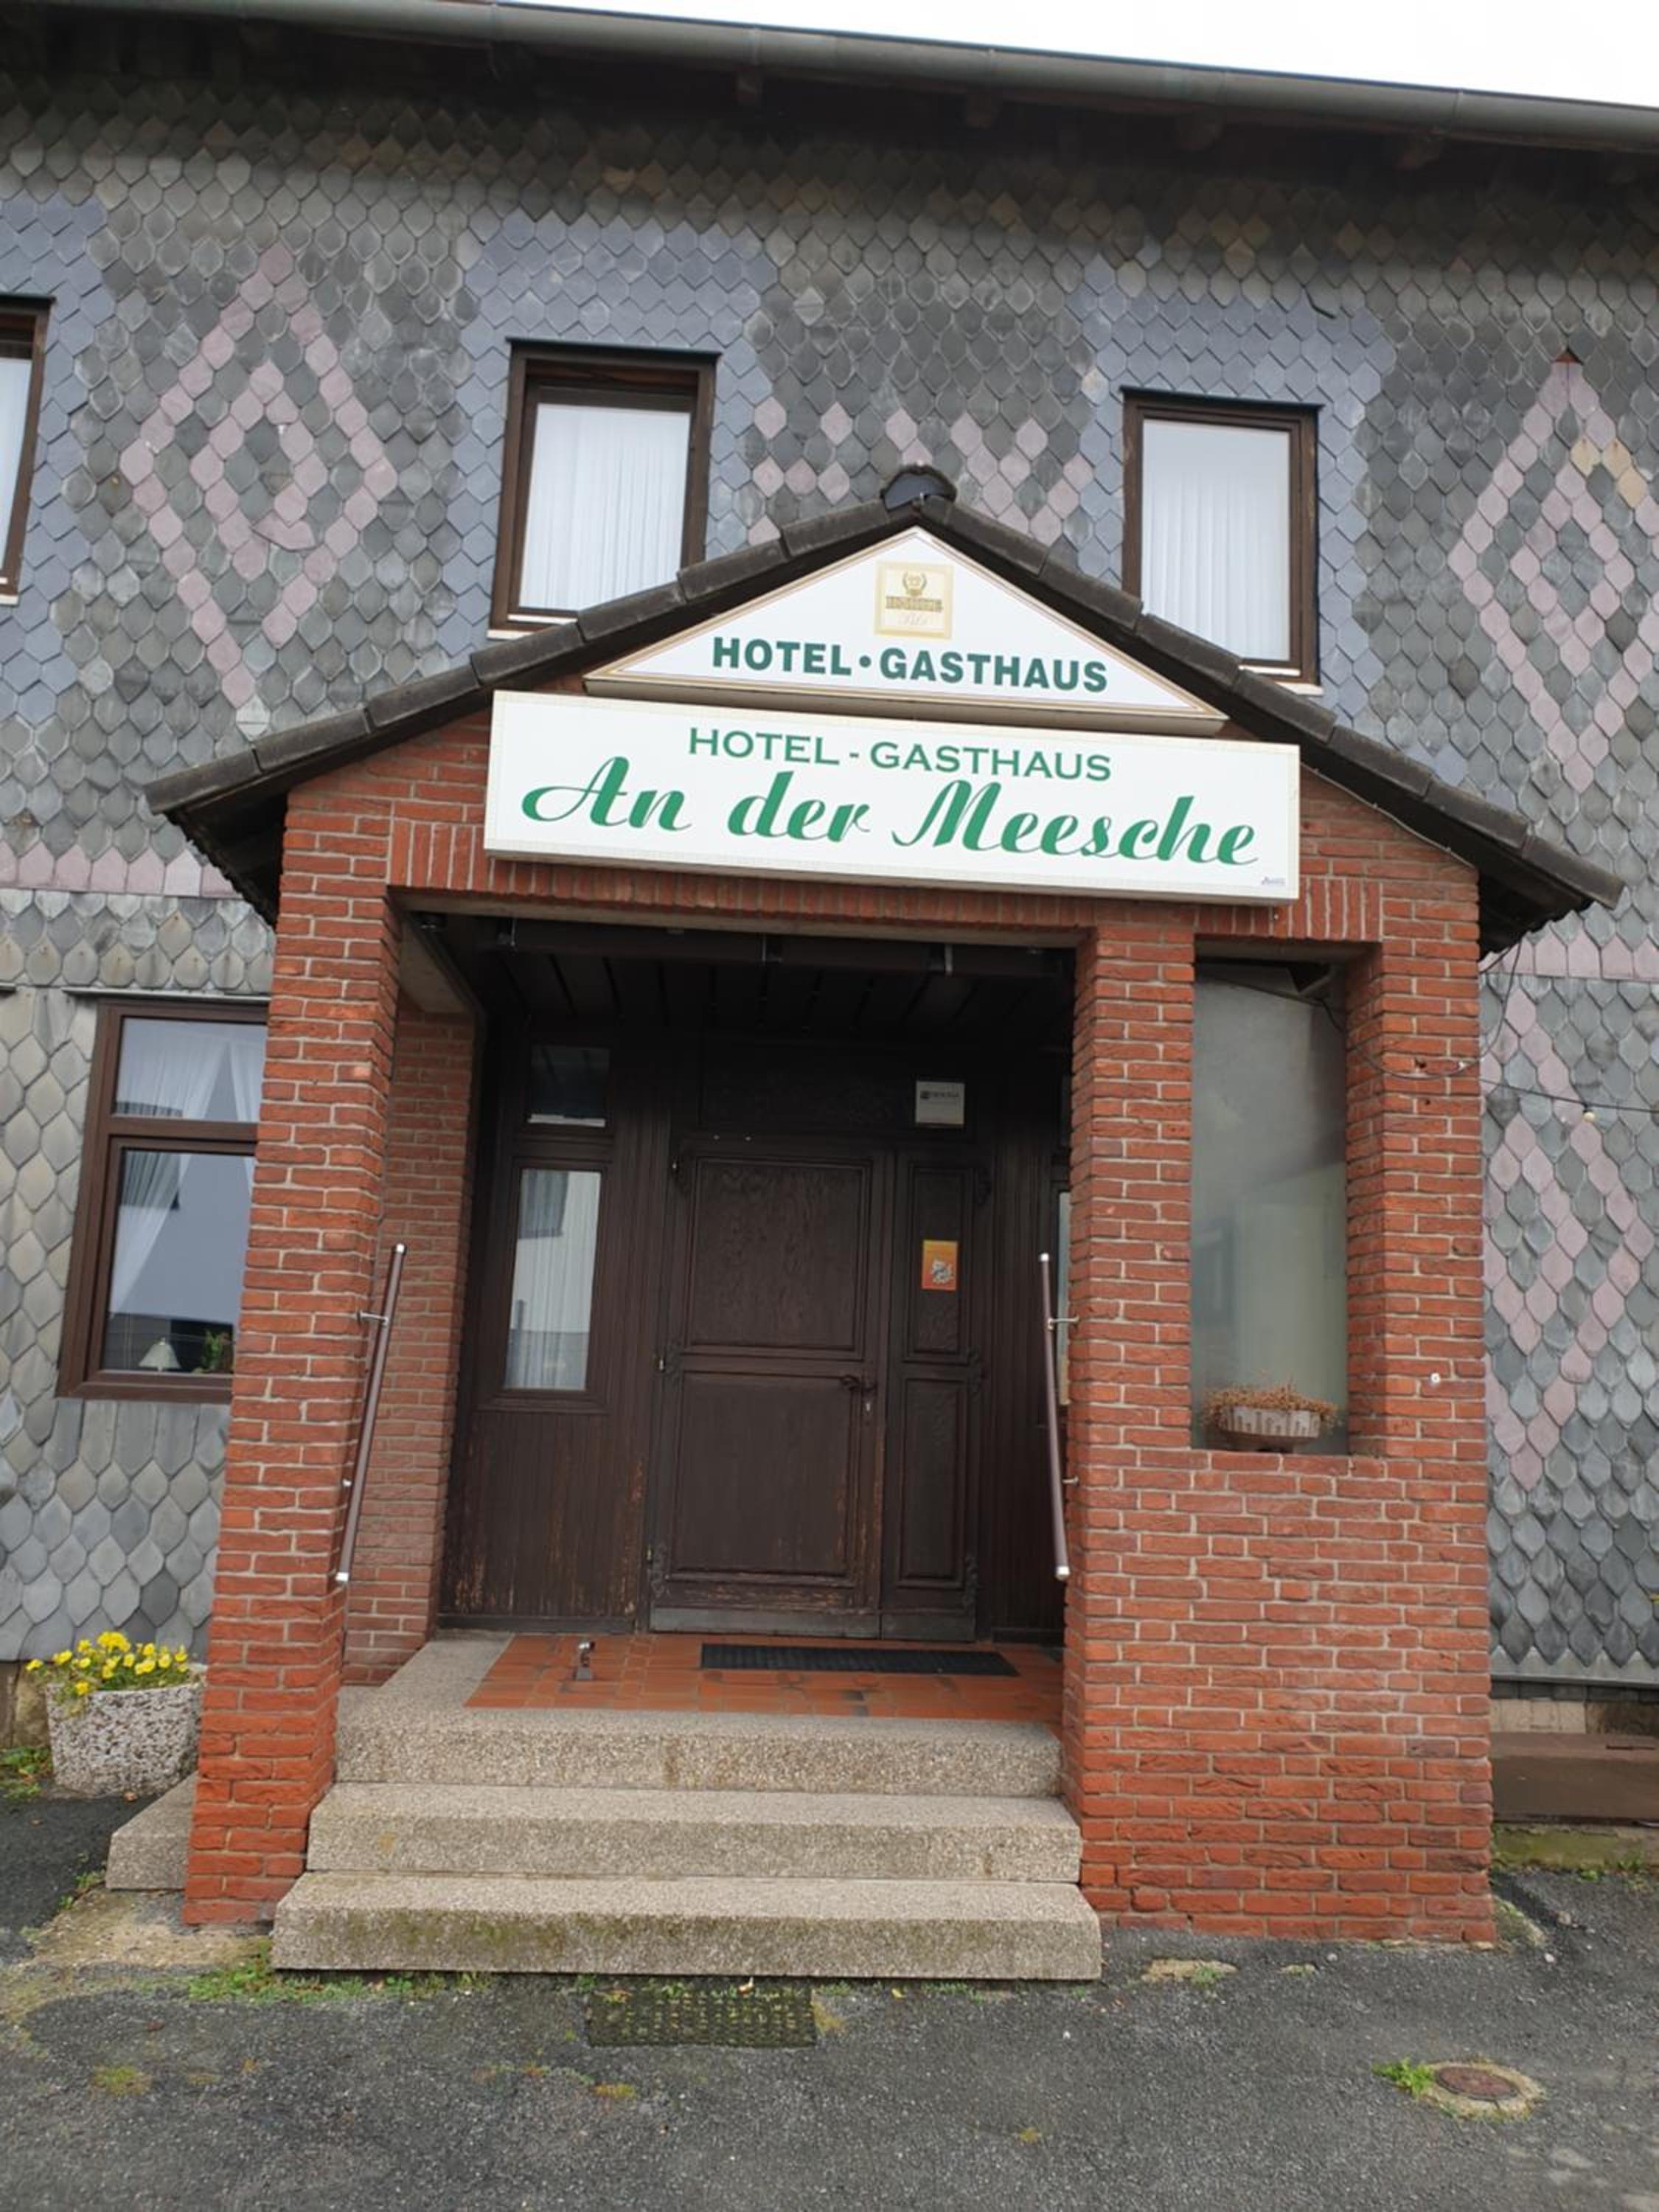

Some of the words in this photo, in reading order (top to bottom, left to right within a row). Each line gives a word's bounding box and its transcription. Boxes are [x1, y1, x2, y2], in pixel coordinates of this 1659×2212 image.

[712, 636, 852, 674] HOTEL
[878, 647, 1110, 693] GASTHAUS
[688, 726, 841, 767] HOTEL
[870, 740, 1112, 784] GASTHAUS
[521, 754, 692, 831] An
[726, 769, 870, 844] der
[891, 776, 1259, 870] Meesche
